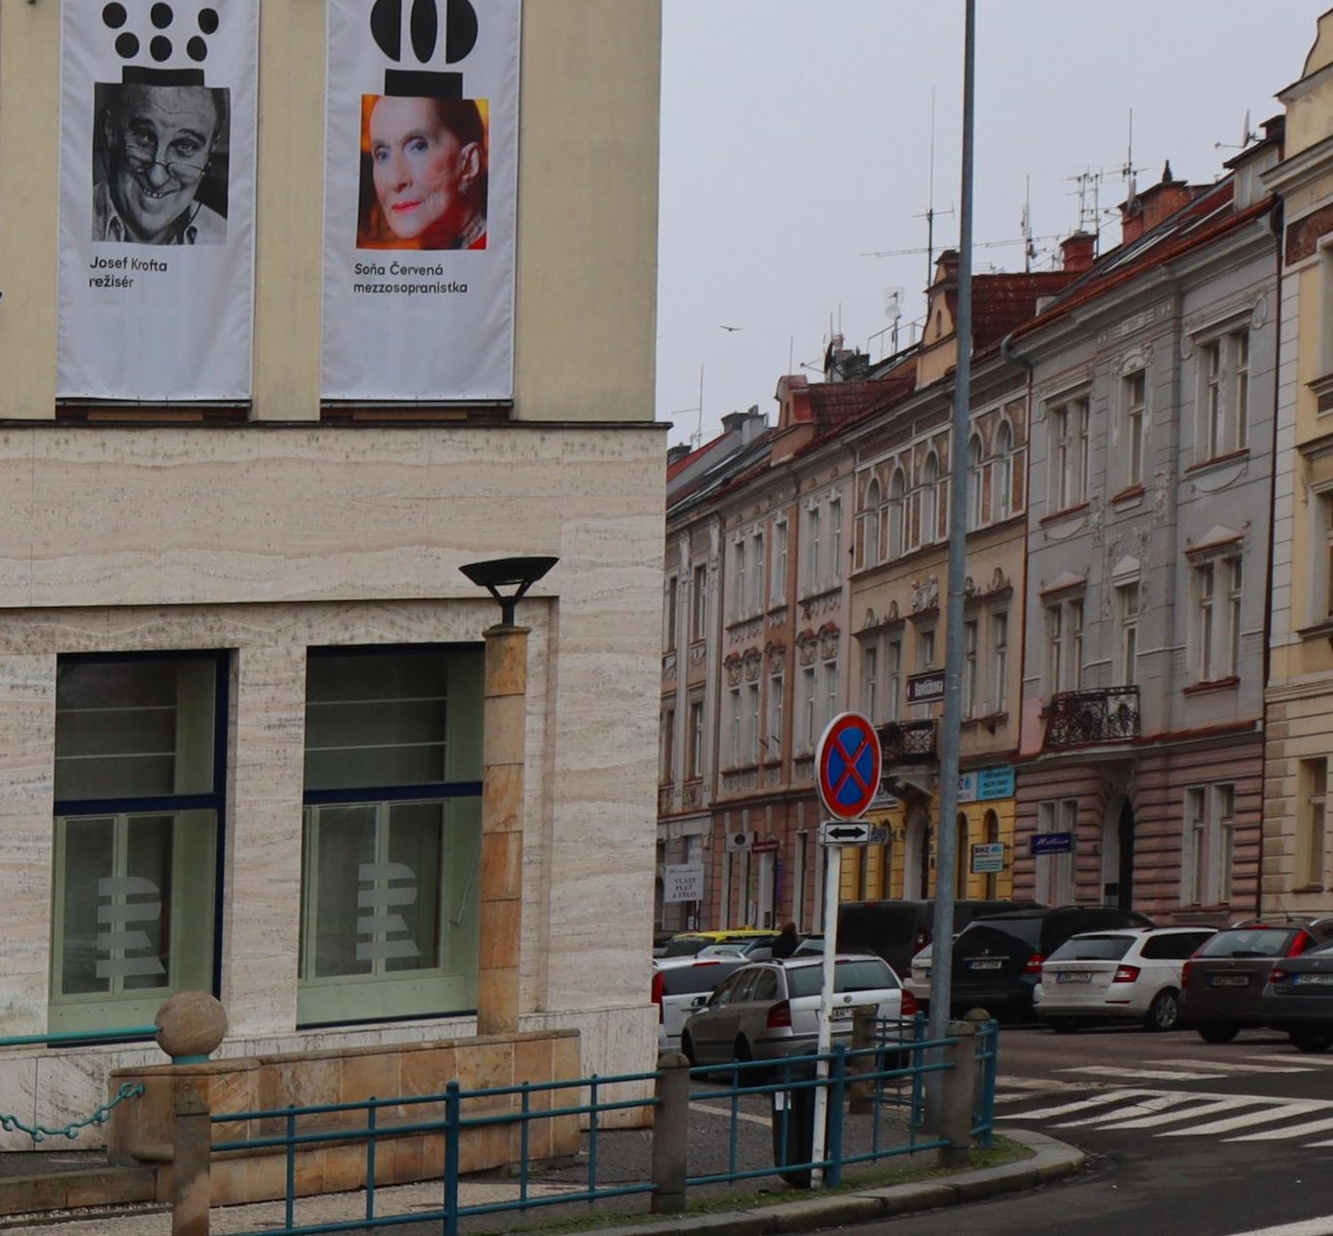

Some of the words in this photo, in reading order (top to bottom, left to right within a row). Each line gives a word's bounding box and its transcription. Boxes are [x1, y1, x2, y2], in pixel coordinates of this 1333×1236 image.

[89, 256, 128, 269] Josef
[131, 258, 168, 272] Krofta
[354, 262, 386, 276] Soňa
[389, 260, 444, 276] Červená
[89, 274, 134, 288] režisér
[353, 280, 468, 296] mezzosopranistka
